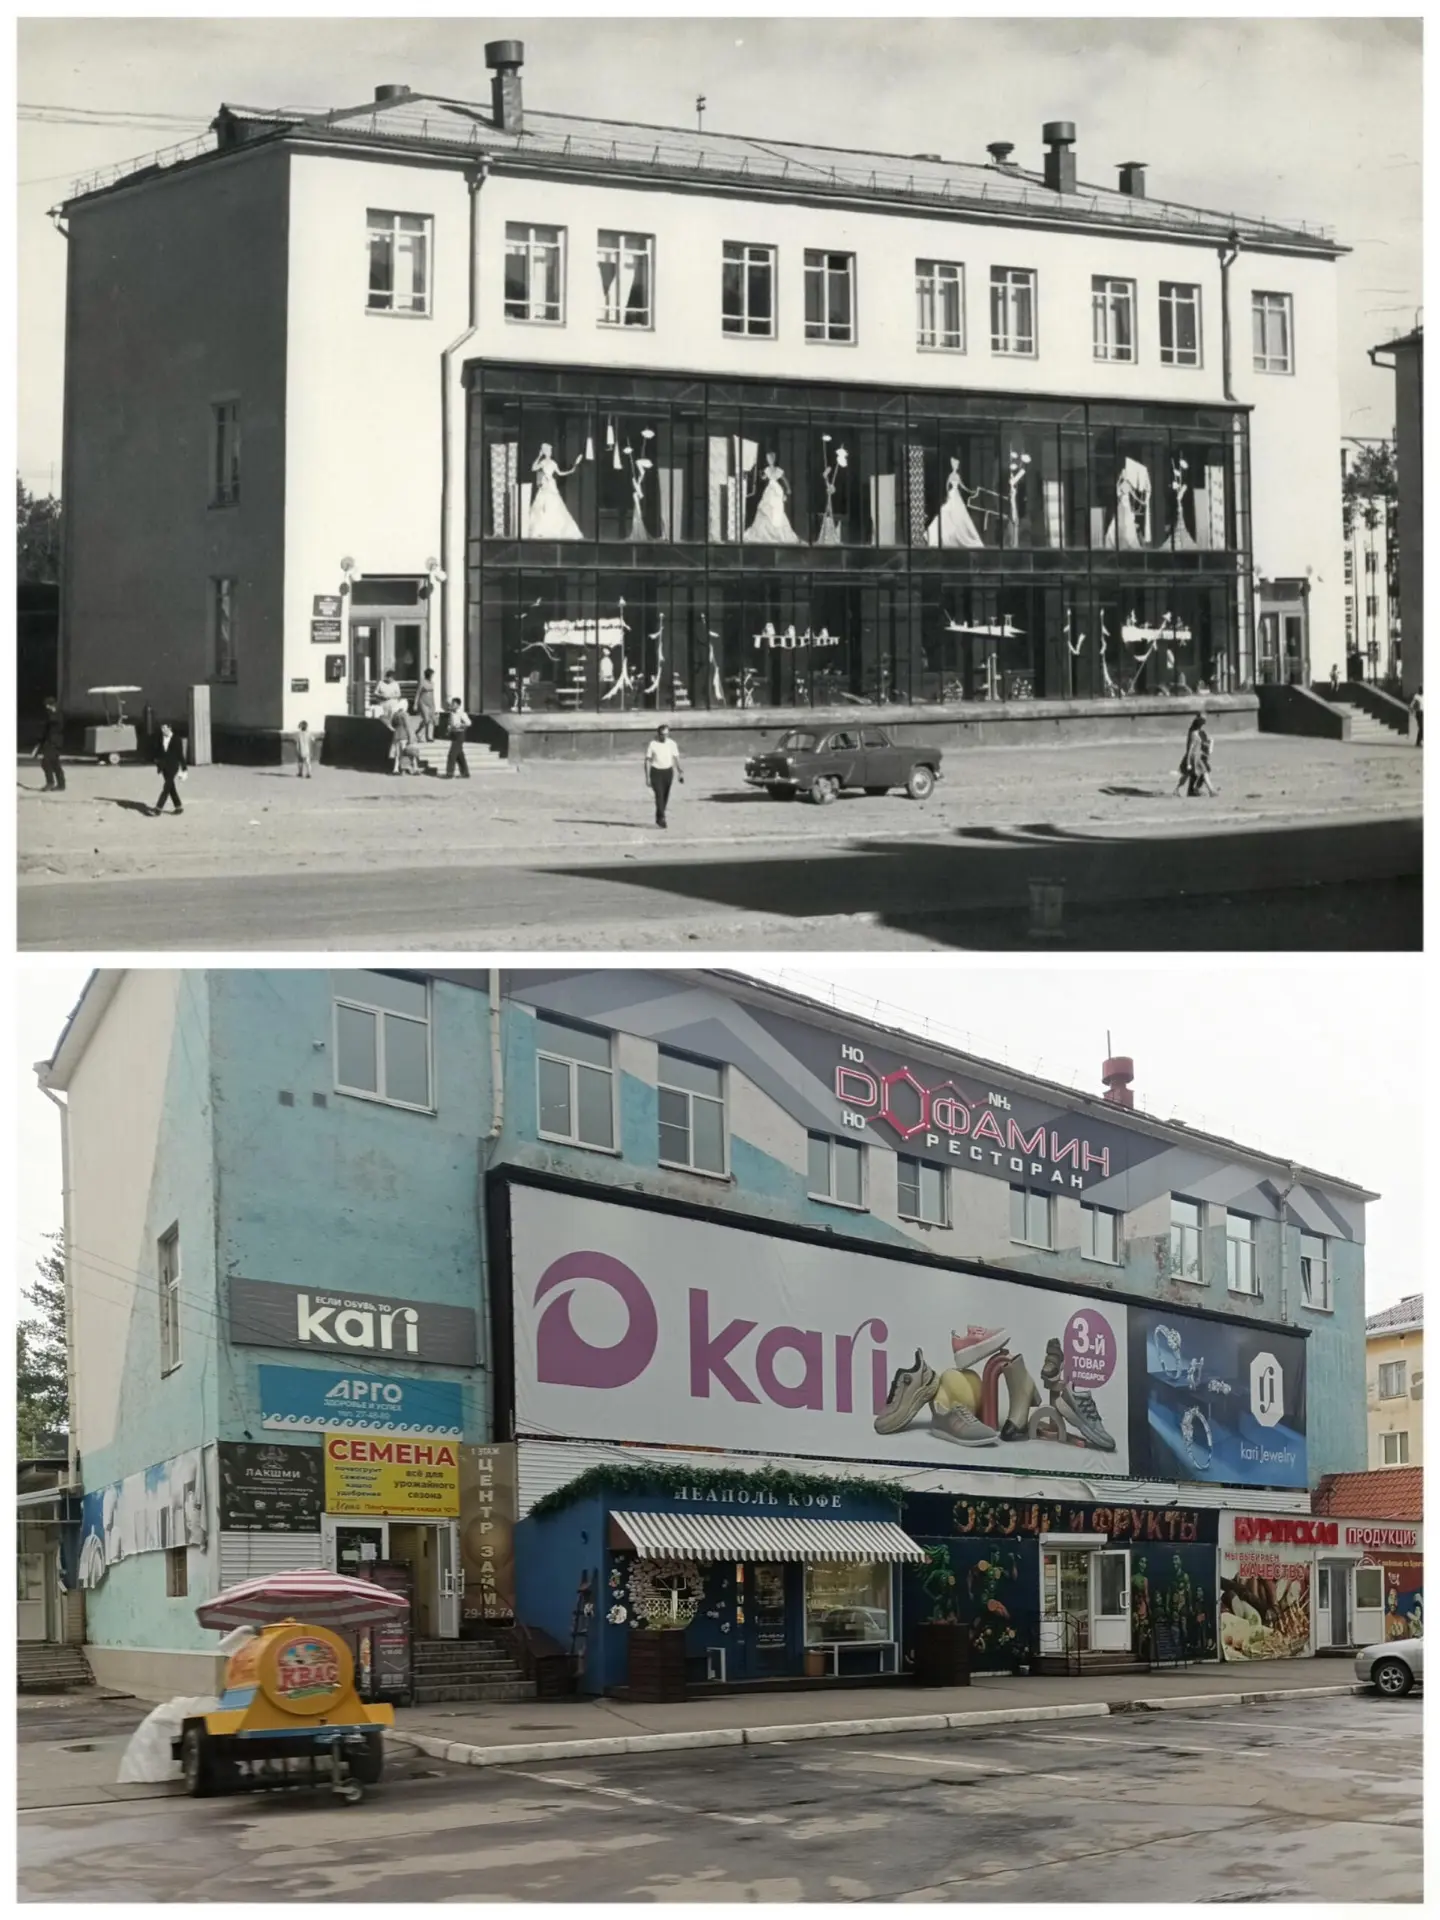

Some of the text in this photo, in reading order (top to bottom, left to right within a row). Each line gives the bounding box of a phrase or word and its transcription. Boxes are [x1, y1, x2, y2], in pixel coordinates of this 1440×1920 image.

[926, 1133, 1083, 1189] РЕСТОРАН
[315, 1296, 342, 1307] ЕСЛИ
[378, 1304, 392, 1313] ТО
[297, 1294, 419, 1353] kari
[689, 1287, 889, 1416] kari
[1072, 1356, 1105, 1370] ТОВАР
[325, 1380, 403, 1403] АРГО
[328, 1439, 456, 1466] СЕМЕНА
[1240, 1442, 1259, 1461] kari
[245, 1468, 301, 1478] ЛАКШМИ
[406, 1469, 444, 1479] всё для
[393, 1480, 456, 1490] урожайного
[408, 1491, 443, 1500] сезона
[478, 1458, 494, 1535] ЦЕНТР
[788, 1493, 842, 1508] КОФЕ
[1091, 1506, 1198, 1542] ФРУКТЫ
[1346, 1527, 1417, 1548] ПРОДУКЦИЯ
[1224, 1551, 1281, 1563] МЫ ВЫБИРАЕМ
